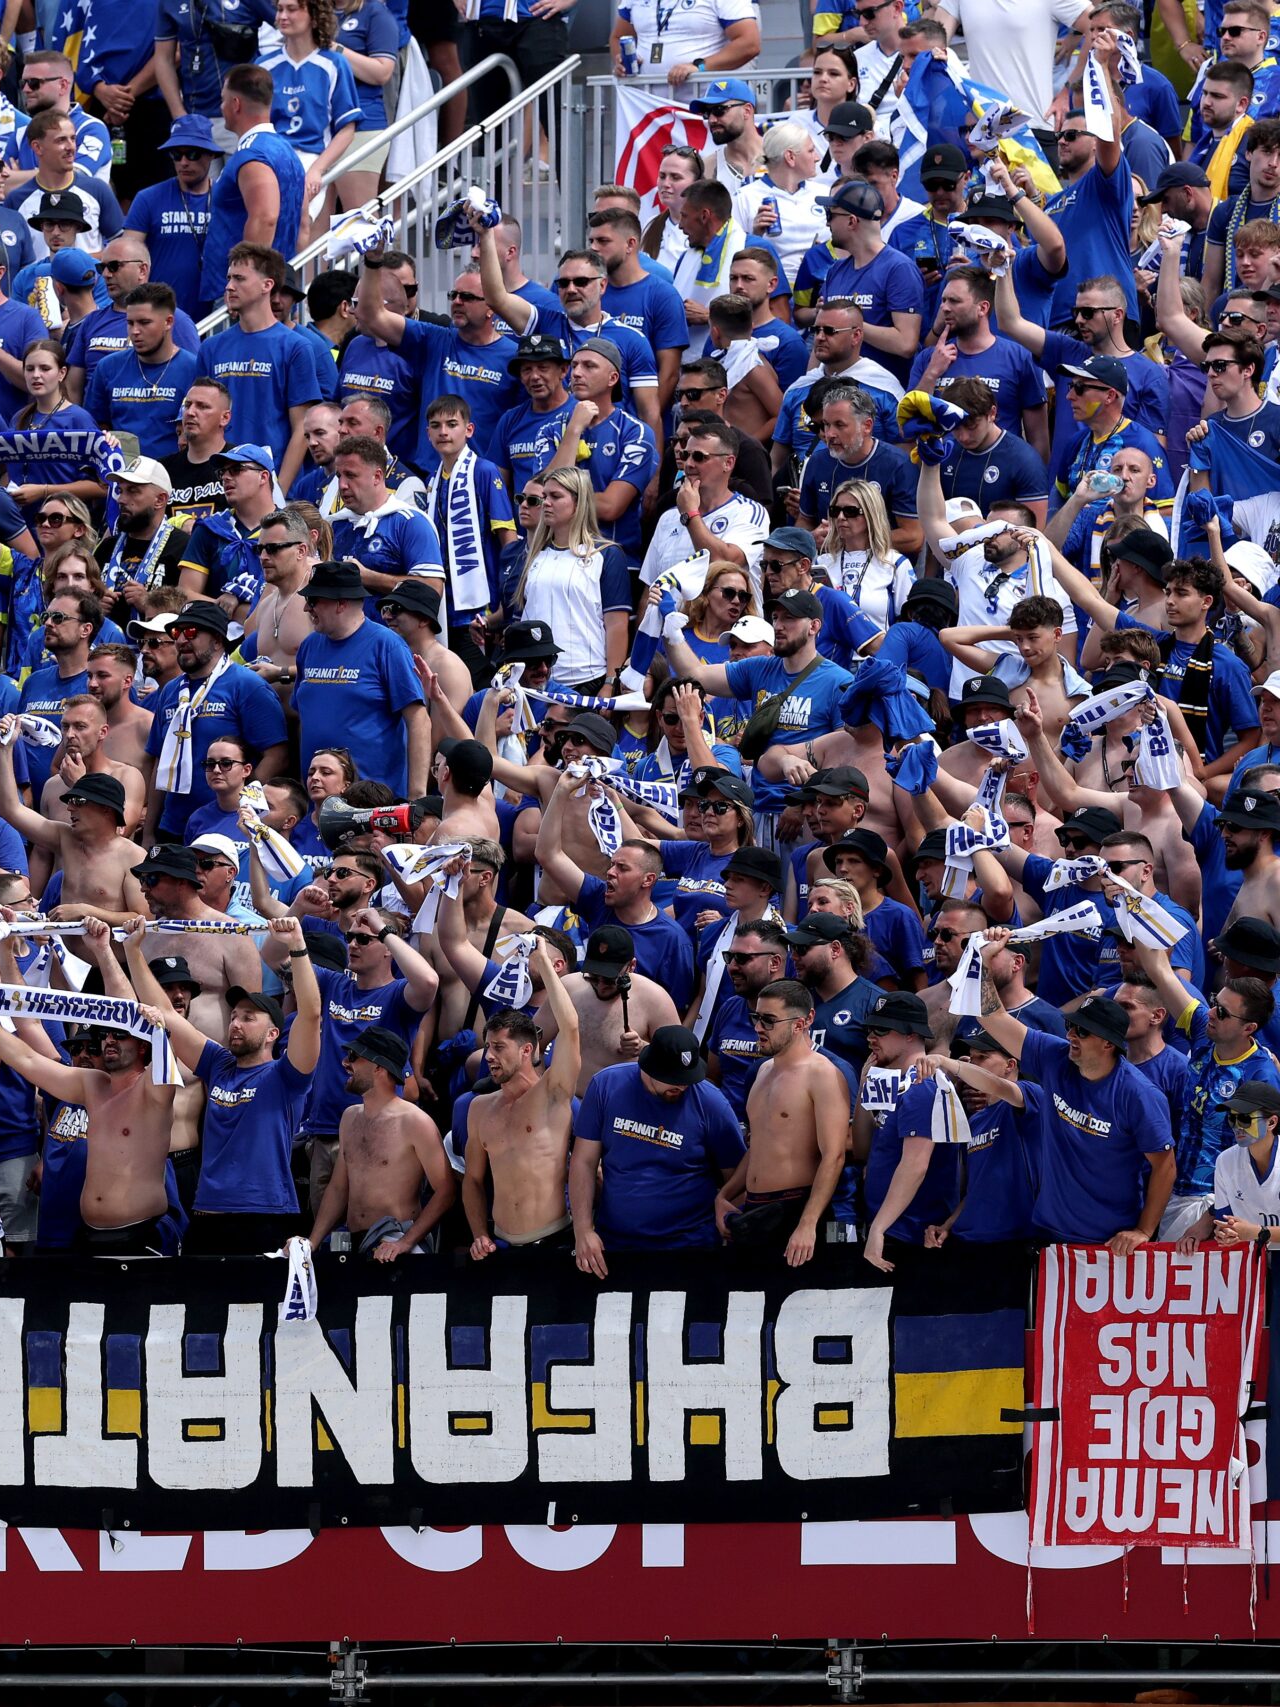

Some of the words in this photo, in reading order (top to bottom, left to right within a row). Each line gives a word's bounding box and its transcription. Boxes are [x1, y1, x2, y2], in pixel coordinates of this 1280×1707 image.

[161, 211, 195, 225] STAND
[25, 452, 83, 463] SUPPORT
[613, 1116, 684, 1146] BHFANATICOS
[1052, 1091, 1111, 1135] BHFANATICOS
[1073, 1249, 1244, 1315] NEMA
[1097, 1322, 1208, 1388] NAS
[1087, 1387, 1216, 1461] GDJE
[1063, 1467, 1226, 1536] NEMA
